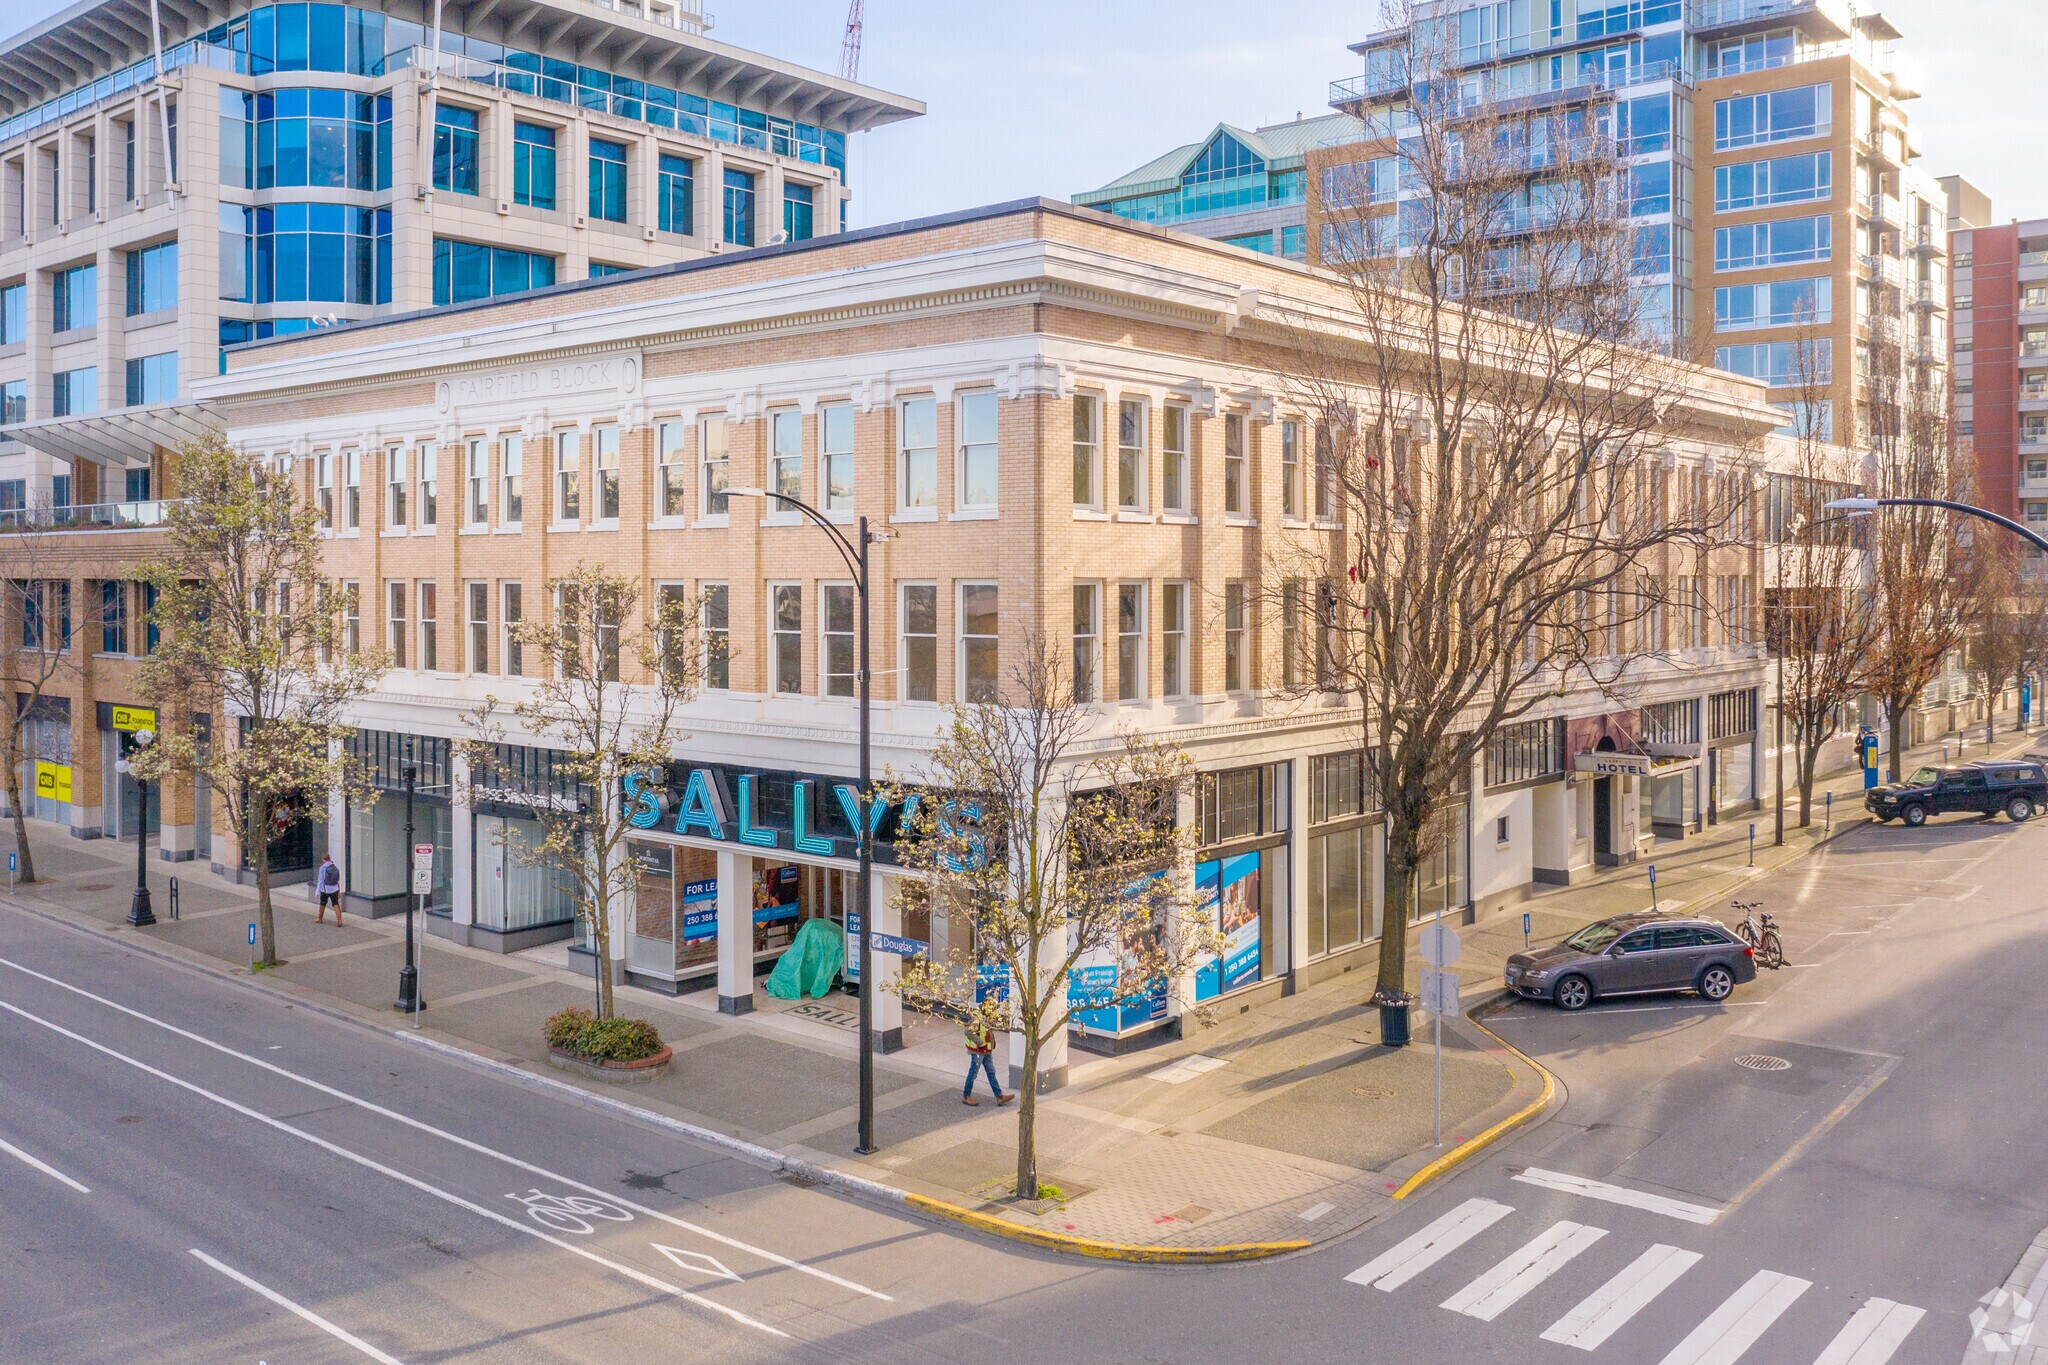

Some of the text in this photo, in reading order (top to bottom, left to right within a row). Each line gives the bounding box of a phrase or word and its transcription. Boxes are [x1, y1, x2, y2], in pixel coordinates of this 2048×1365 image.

[459, 362, 611, 400] FAIRFIELD BLOCK
[1597, 763, 1647, 775] HOTEL
[624, 767, 986, 873] SALLY'S
[686, 885, 703, 895] FOR
[686, 916, 700, 925] 250
[701, 914, 713, 922] 388
[883, 937, 913, 952] Douglas
